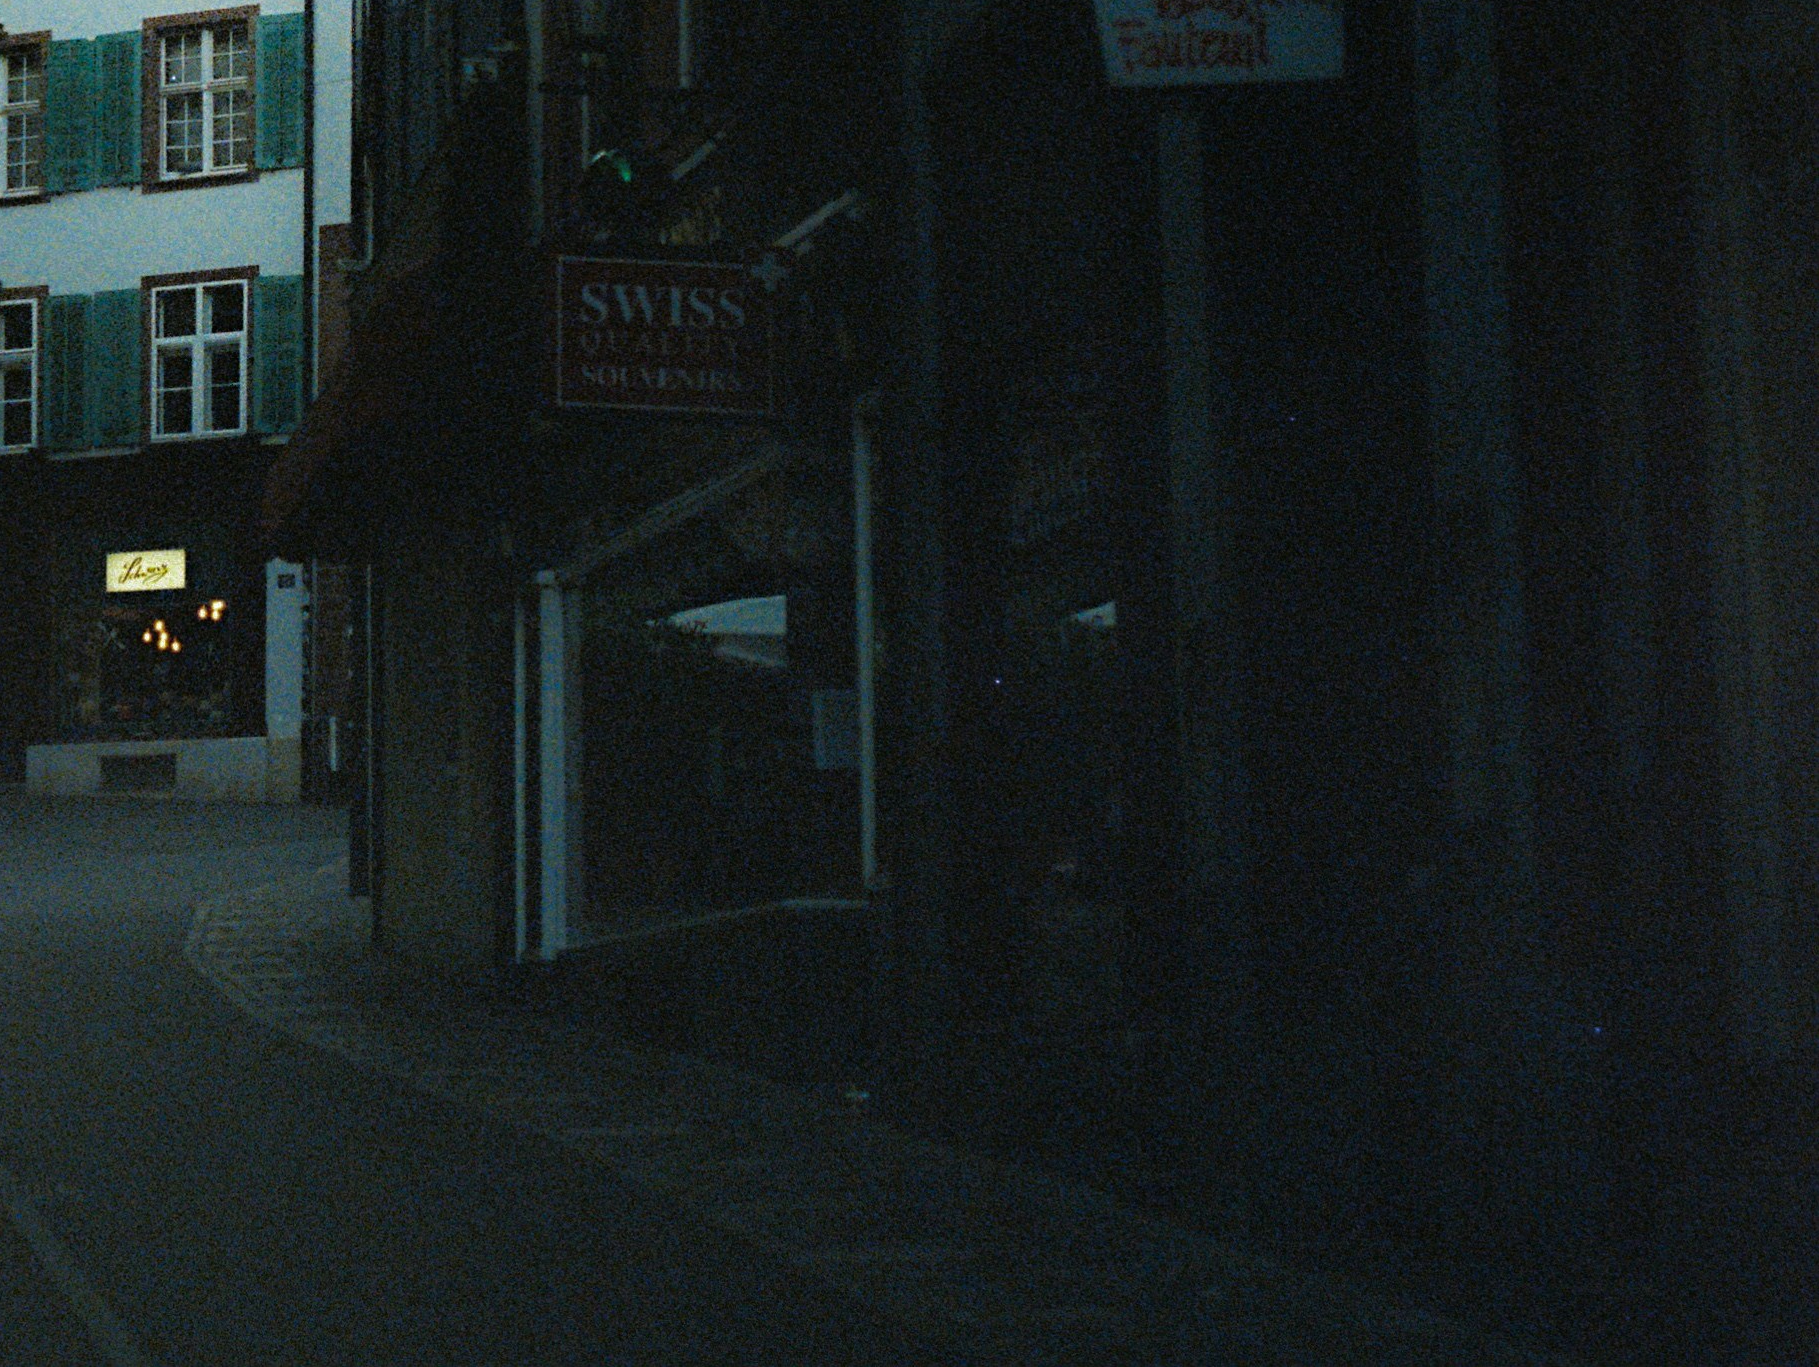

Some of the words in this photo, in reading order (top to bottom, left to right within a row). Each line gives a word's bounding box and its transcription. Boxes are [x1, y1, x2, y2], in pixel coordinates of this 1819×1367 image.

[580, 283, 746, 327] SWISS
[579, 329, 739, 359] QUALITY
[581, 364, 745, 392] SOUVENIRS
